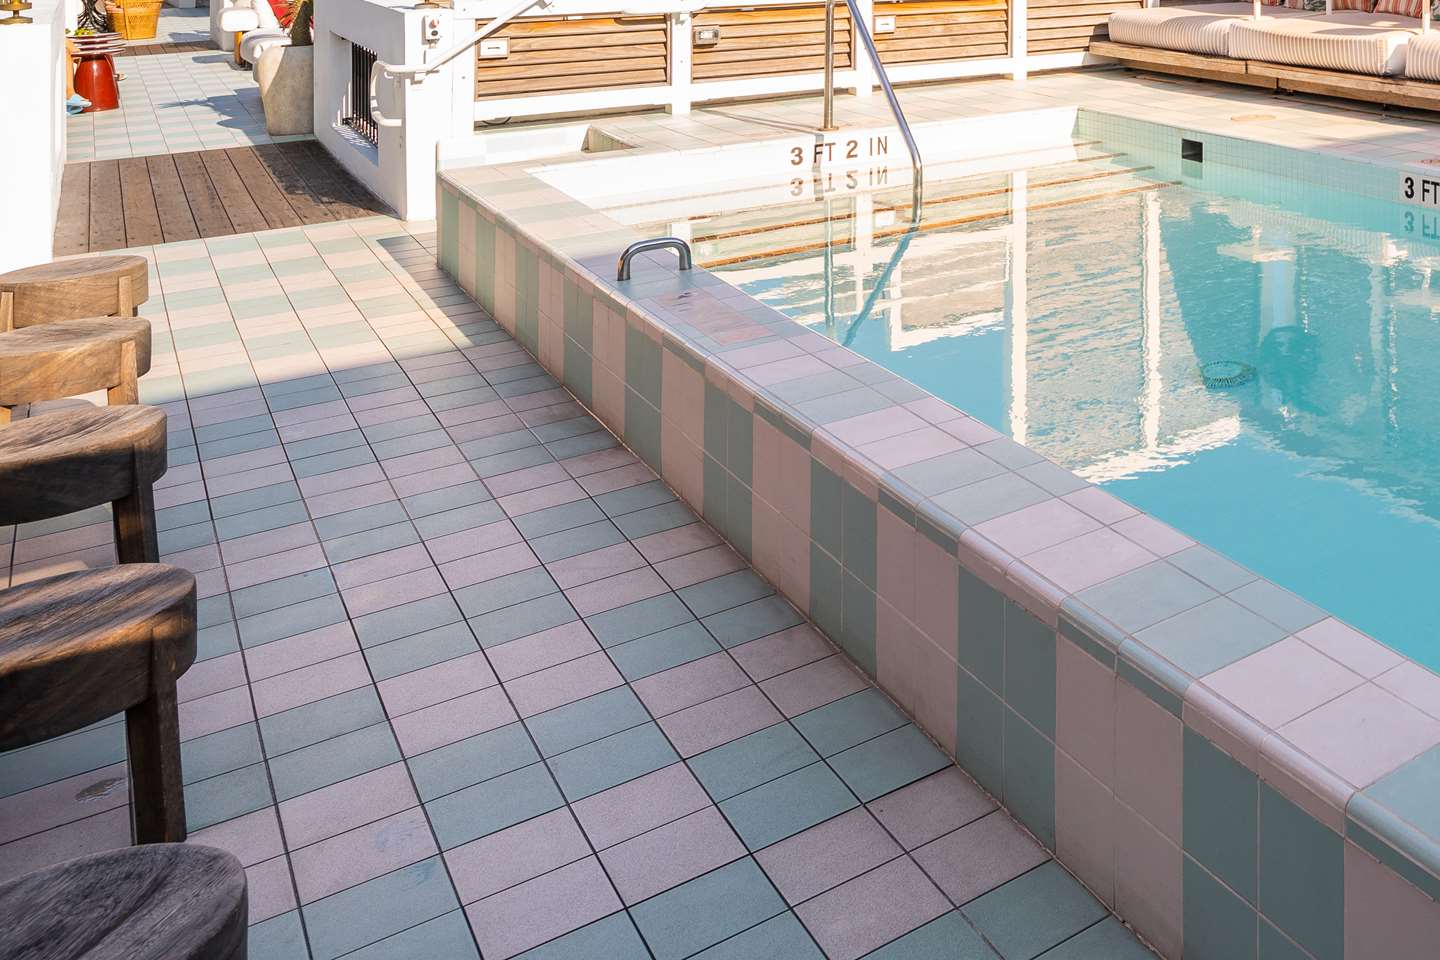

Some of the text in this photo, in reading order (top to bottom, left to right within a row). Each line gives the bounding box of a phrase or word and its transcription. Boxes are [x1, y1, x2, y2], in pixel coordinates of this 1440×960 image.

[790, 135, 888, 166] 3 FT 2 IN
[1404, 176, 1415, 199] 3
[1422, 179, 1440, 205] FT
